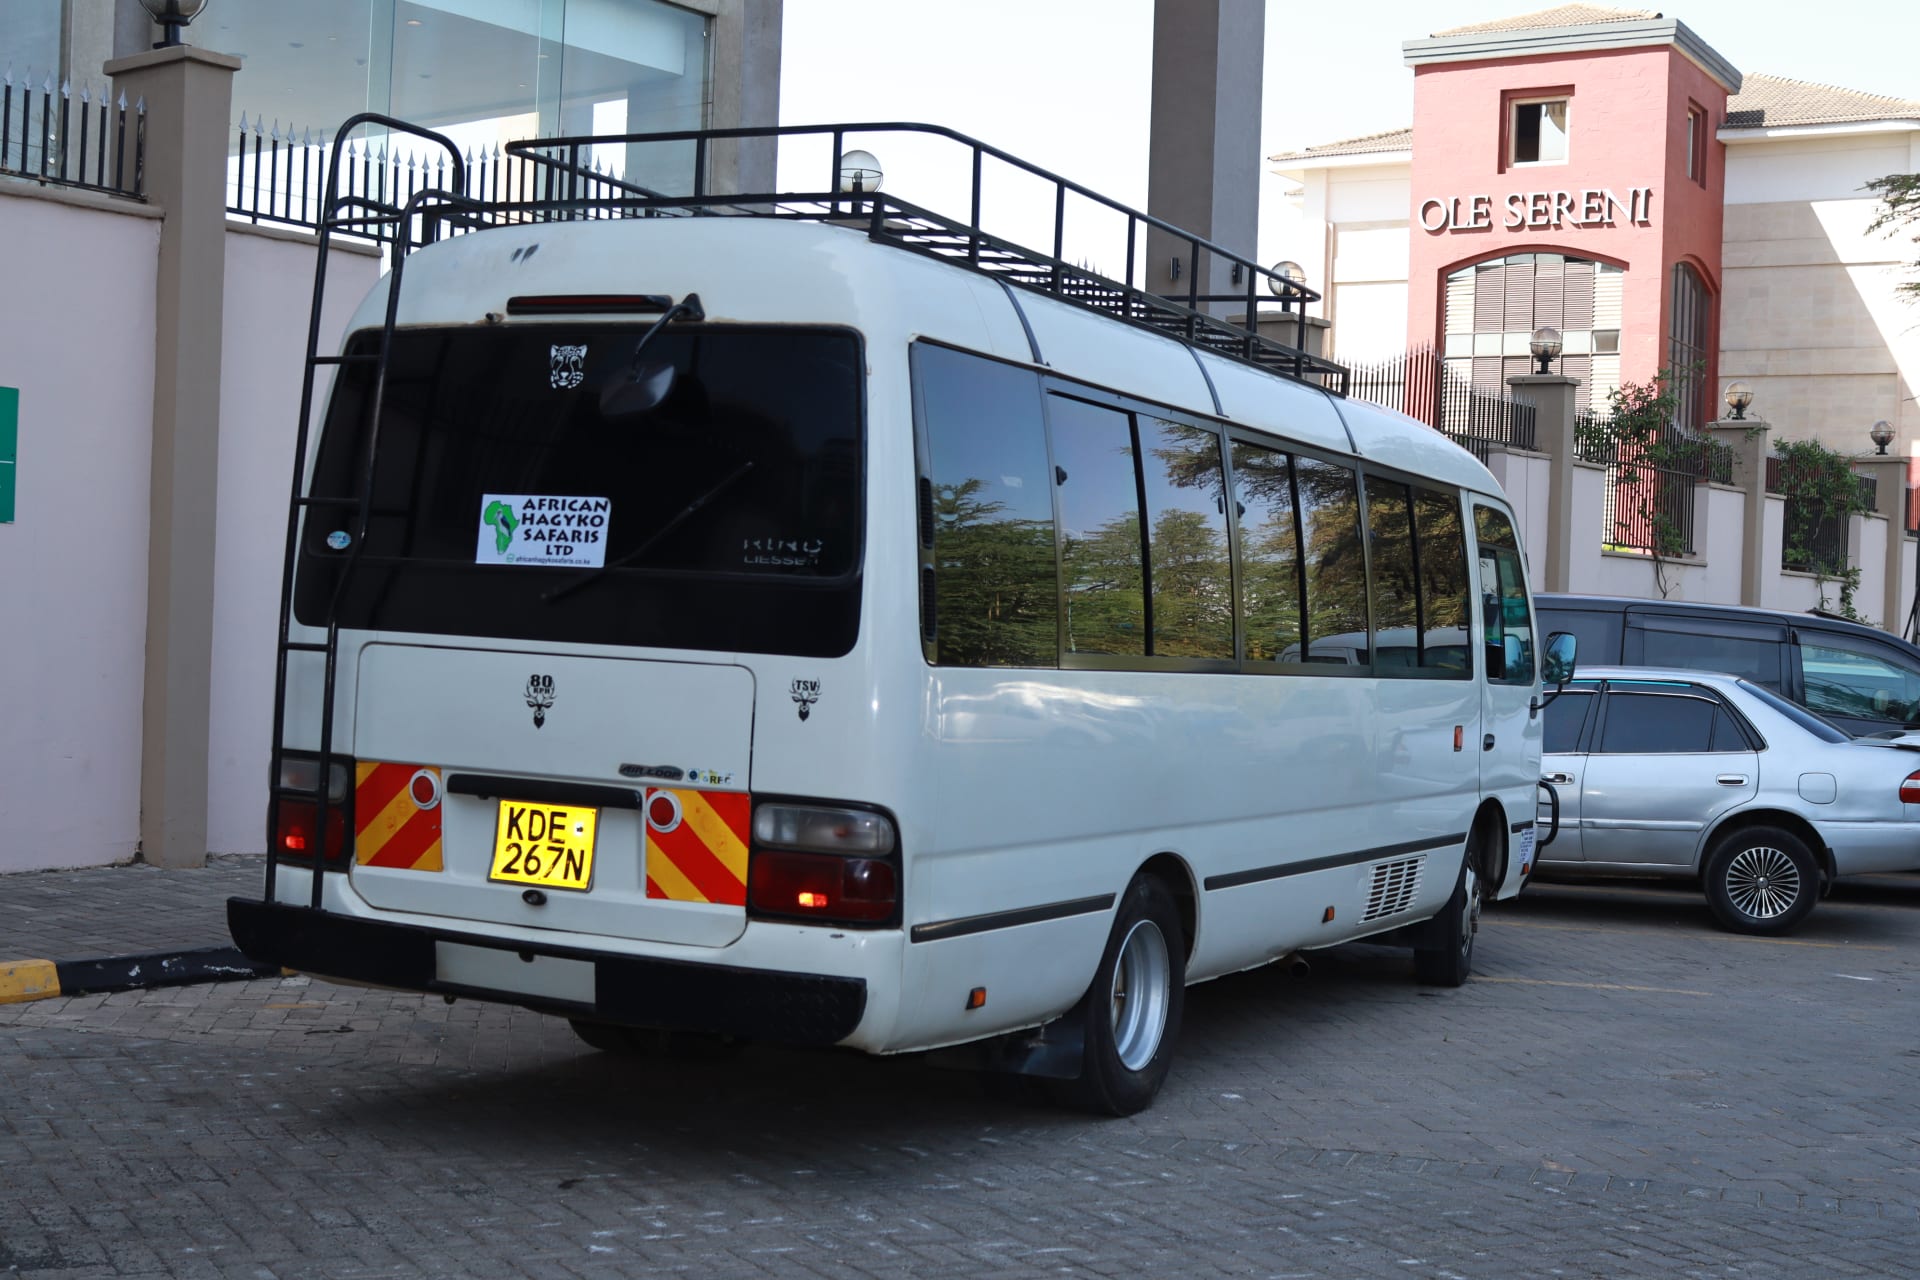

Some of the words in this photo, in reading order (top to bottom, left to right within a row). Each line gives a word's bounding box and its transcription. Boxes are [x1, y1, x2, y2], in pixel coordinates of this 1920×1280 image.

[1418, 195, 1492, 232] OLE
[1502, 187, 1650, 228] SERENI
[522, 498, 608, 512] AFRICAN
[521, 513, 604, 527] HAGYKO
[523, 528, 599, 543] SAFARIS
[546, 544, 573, 556] LTD
[530, 674, 552, 688] 80
[796, 680, 817, 691] TSV
[507, 807, 567, 844] KDE
[501, 842, 585, 881] 267N
